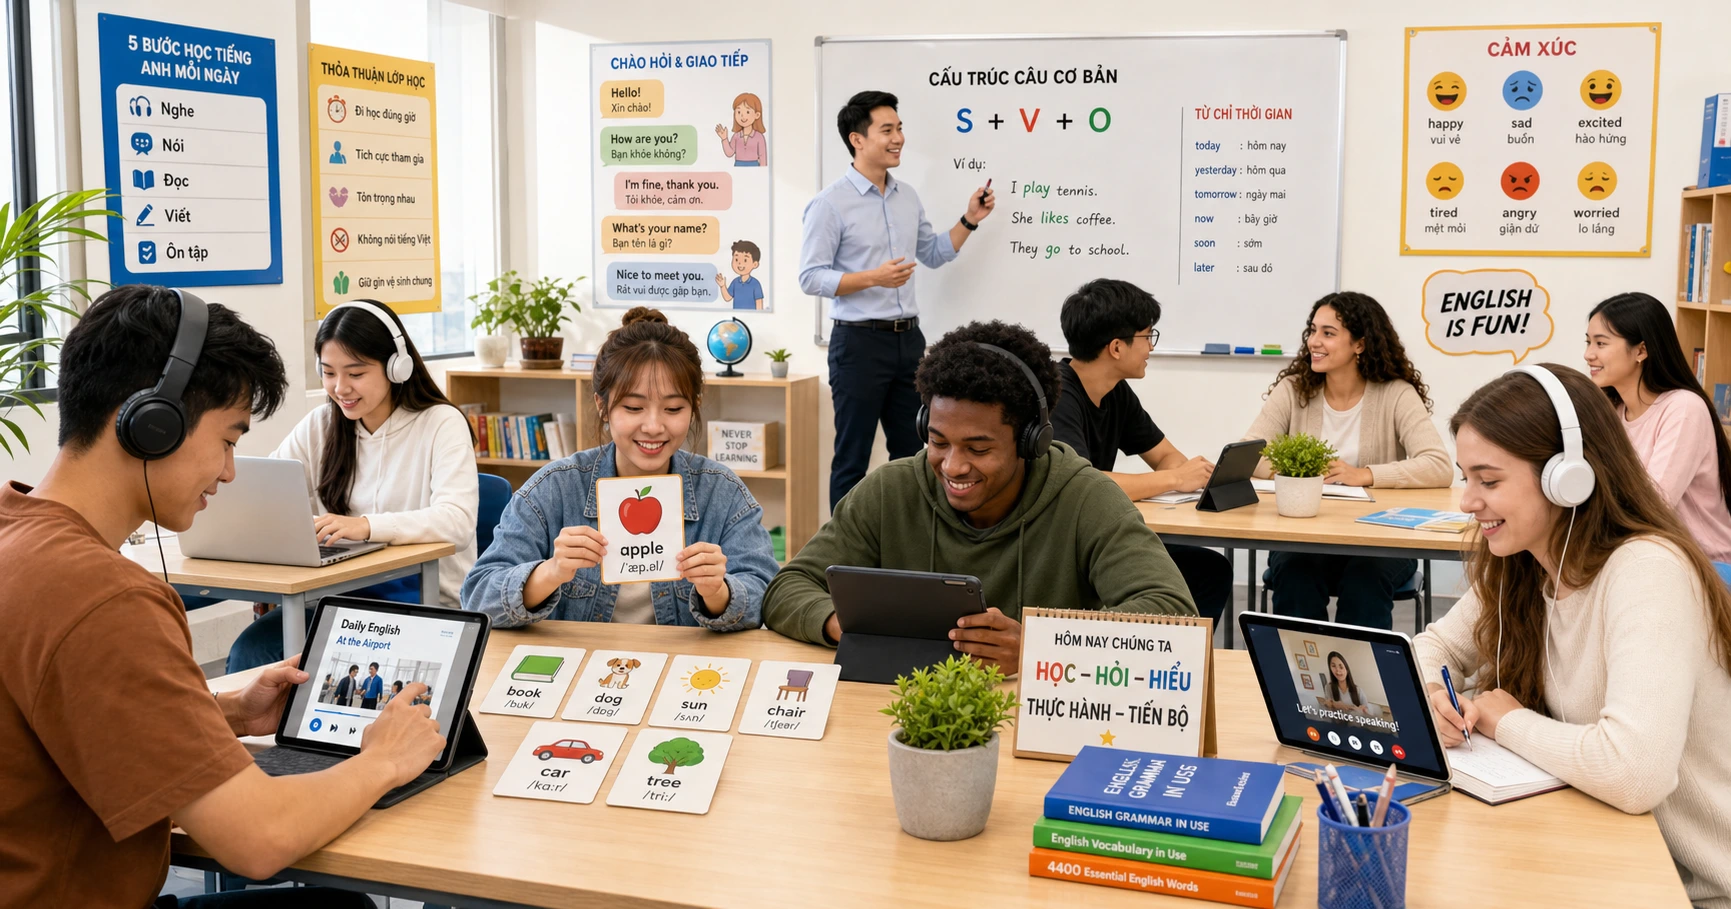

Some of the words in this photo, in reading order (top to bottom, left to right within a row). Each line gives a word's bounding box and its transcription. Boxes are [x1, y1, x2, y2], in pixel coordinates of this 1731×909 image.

[128, 35, 138, 51] 5
[142, 36, 180, 56] BƯỚC
[184, 43, 212, 62] HỌC
[215, 44, 251, 65] TIẾNG
[1488, 37, 1530, 57] CẢM
[1537, 37, 1576, 56] XÚC
[611, 54, 646, 69] CHÀO
[675, 58, 682, 68] &
[686, 55, 717, 68] GIAO
[721, 48, 748, 66] TIẾP
[141, 60, 171, 77] ANH
[204, 67, 239, 85] NGÀY
[929, 66, 962, 86] CẤU
[968, 67, 1009, 85] TRÚC
[1015, 67, 1047, 85] CÂU
[1054, 68, 1077, 84] CƠ
[1083, 65, 1117, 83] BẢN
[407, 75, 425, 90] HỌC
[612, 87, 641, 98] Hello!
[161, 102, 194, 120] Nghe
[355, 106, 364, 116] Đi
[366, 107, 380, 120] học
[612, 103, 625, 112] Xin
[1195, 105, 1211, 119] TỪ
[1236, 105, 1261, 119] THỜI
[1265, 108, 1292, 119] GIAN
[956, 108, 973, 133] S
[1019, 108, 1040, 132] V
[1089, 107, 1111, 133] O
[1429, 118, 1463, 131] happy
[1511, 118, 1532, 128] sad
[1578, 117, 1621, 128] excited
[163, 138, 184, 152] Nói
[611, 134, 632, 143] How
[654, 133, 678, 146] you?
[1431, 134, 1445, 144] vui
[1195, 140, 1220, 152] today
[1270, 143, 1286, 152] nay
[392, 152, 411, 163] tham
[413, 154, 424, 166] gia
[612, 150, 627, 161] Bạn
[954, 158, 965, 169] Ví
[968, 159, 986, 172] dụ:
[1195, 165, 1236, 176] yesterday
[1269, 168, 1285, 177] qua
[164, 173, 189, 190] Đọc
[625, 180, 639, 189] I'm
[642, 179, 663, 191] fine,
[667, 180, 694, 189] thank
[698, 181, 719, 192] you.
[1011, 181, 1017, 193] I
[1023, 181, 1050, 198] play
[1057, 186, 1097, 196] tennis.
[1195, 190, 1237, 199] tomorrow
[1270, 190, 1285, 199] mai
[374, 194, 395, 205] trọng
[397, 194, 415, 203] nhau
[689, 196, 703, 204] ơn.
[165, 208, 191, 222] Viết
[1012, 212, 1032, 223] She
[1041, 211, 1068, 224] likes
[1076, 213, 1115, 226] coffee.
[1430, 208, 1457, 218] tired
[1503, 209, 1537, 220] angry
[1573, 208, 1619, 218] worried
[613, 223, 645, 233] What's
[648, 226, 671, 235] your
[674, 223, 707, 233] name?
[1579, 223, 1588, 233] lo
[613, 238, 629, 250] Bạn
[1010, 241, 1038, 259] They
[1045, 245, 1060, 259] go
[1069, 245, 1081, 255] to
[1088, 244, 1129, 255] school.
[166, 242, 184, 259] Ôn
[189, 245, 208, 262] tập
[1194, 262, 1214, 272] later
[1262, 263, 1272, 272] đó
[397, 276, 410, 286] sinh
[413, 276, 432, 287] chung
[617, 270, 638, 280] Nice
[642, 271, 651, 279] to
[655, 271, 679, 280] meet
[683, 273, 703, 283] you.
[633, 285, 645, 294] vui
[692, 286, 711, 297] bạn.
[1441, 289, 1532, 313] ENGLISH
[1446, 319, 1465, 337] IS
[1471, 313, 1530, 336] FUN!
[722, 430, 752, 438] NEVER
[725, 442, 748, 450] STOP
[716, 453, 757, 463] LEARNING
[621, 541, 663, 559] apple
[341, 619, 366, 633] Daily
[368, 622, 400, 636] English
[336, 635, 346, 645] At
[348, 637, 361, 646] the
[362, 639, 391, 651] Airport
[1055, 631, 1081, 646] HÔM
[1086, 635, 1109, 648] NAY
[1112, 635, 1154, 651] CHÚNG
[1158, 640, 1172, 652] TA
[1036, 661, 1076, 687] HỌC
[1096, 660, 1129, 687] HỎI
[1149, 661, 1191, 691] HIỂU
[507, 687, 541, 698] book
[594, 693, 622, 706] dog
[681, 700, 707, 711] sun
[767, 706, 806, 719] chair
[1027, 697, 1065, 721] THỰC
[1070, 698, 1111, 721] HÀNH
[1129, 700, 1162, 725] TIẾN
[1168, 705, 1188, 731] BỘ
[1319, 708, 1353, 722] practice
[1355, 715, 1399, 732] speaking!
[541, 768, 570, 778] car
[647, 775, 681, 788] tree
[1068, 805, 1112, 820] ENGLISH
[1116, 813, 1172, 827] GRAMMAR
[1176, 819, 1187, 828] IN
[1190, 820, 1209, 832] USE
[1051, 833, 1089, 847] English
[1092, 839, 1153, 858] Vocabulary
[1155, 847, 1165, 857] in
[1168, 849, 1187, 860] Use
[1048, 861, 1081, 876] 4400
[1084, 868, 1127, 881] Essential
[1129, 874, 1164, 888] English
[1167, 878, 1198, 892] Words
